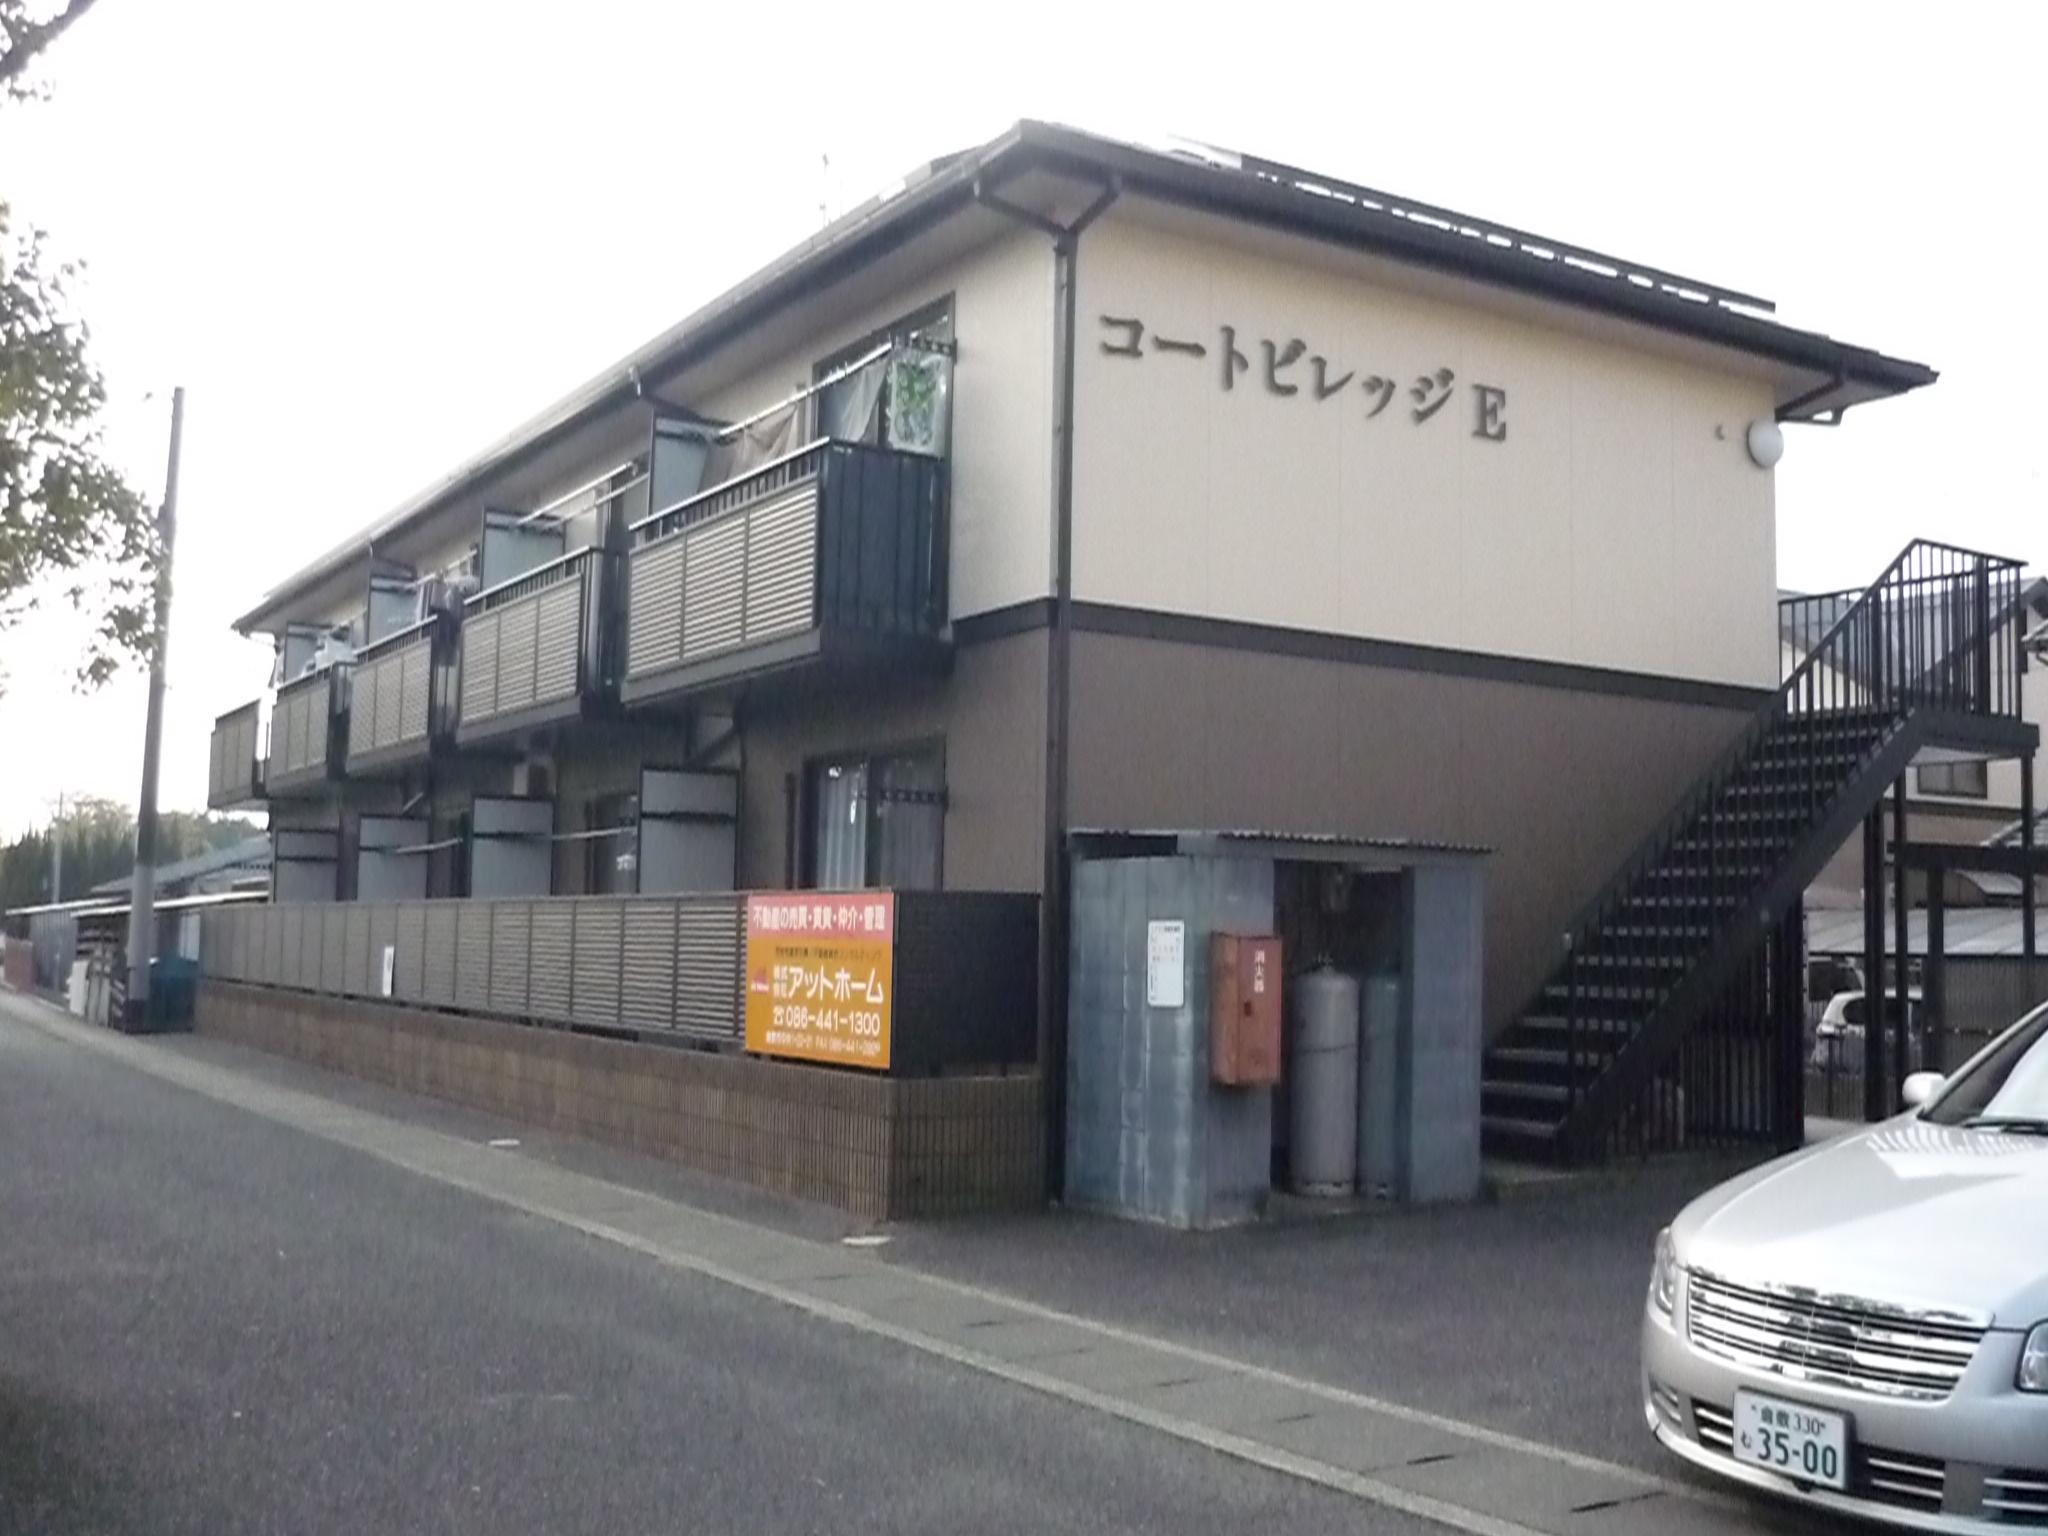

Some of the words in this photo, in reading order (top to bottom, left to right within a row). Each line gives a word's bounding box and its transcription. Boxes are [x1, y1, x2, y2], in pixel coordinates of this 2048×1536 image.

[1099, 315, 1455, 425] コートビレッジ
[1471, 383, 1507, 442] E
[1761, 1405, 1790, 1428] 倉敷
[1794, 1413, 1821, 1436] 330
[1757, 1427, 1837, 1479] 35-00
